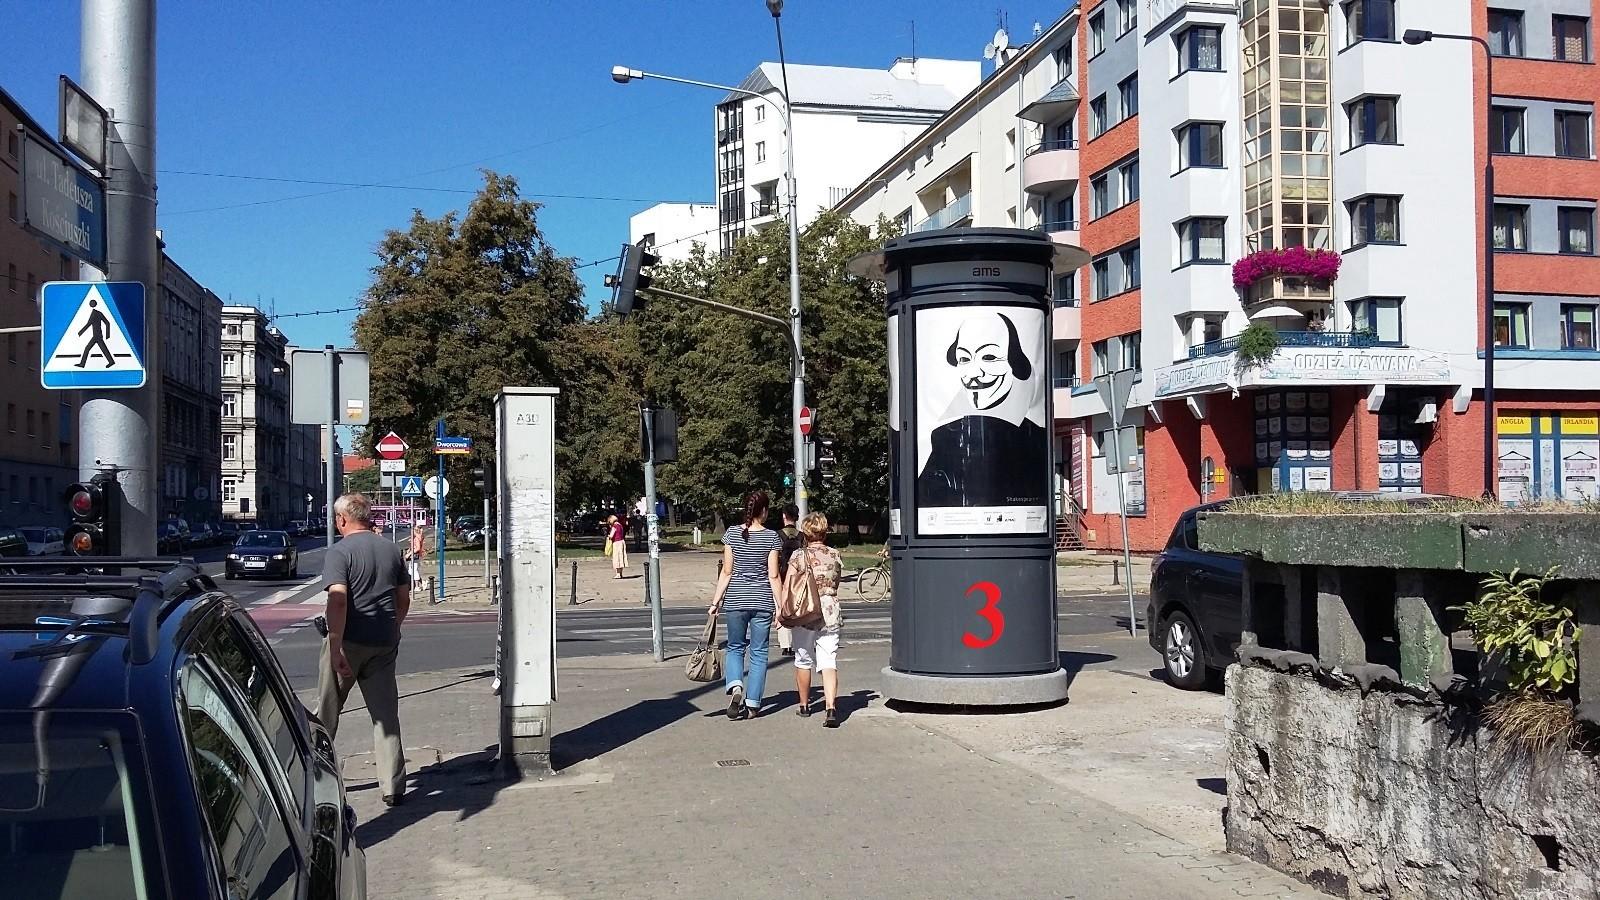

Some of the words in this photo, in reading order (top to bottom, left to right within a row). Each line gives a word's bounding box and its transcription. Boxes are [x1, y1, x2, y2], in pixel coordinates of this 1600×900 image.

[53, 162, 93, 213] Tadeusza
[42, 197, 90, 250] Kościuszki
[972, 267, 1000, 276] ams
[1295, 351, 1344, 370] ODZIEŻ
[1348, 351, 1418, 371] UŻYWANA
